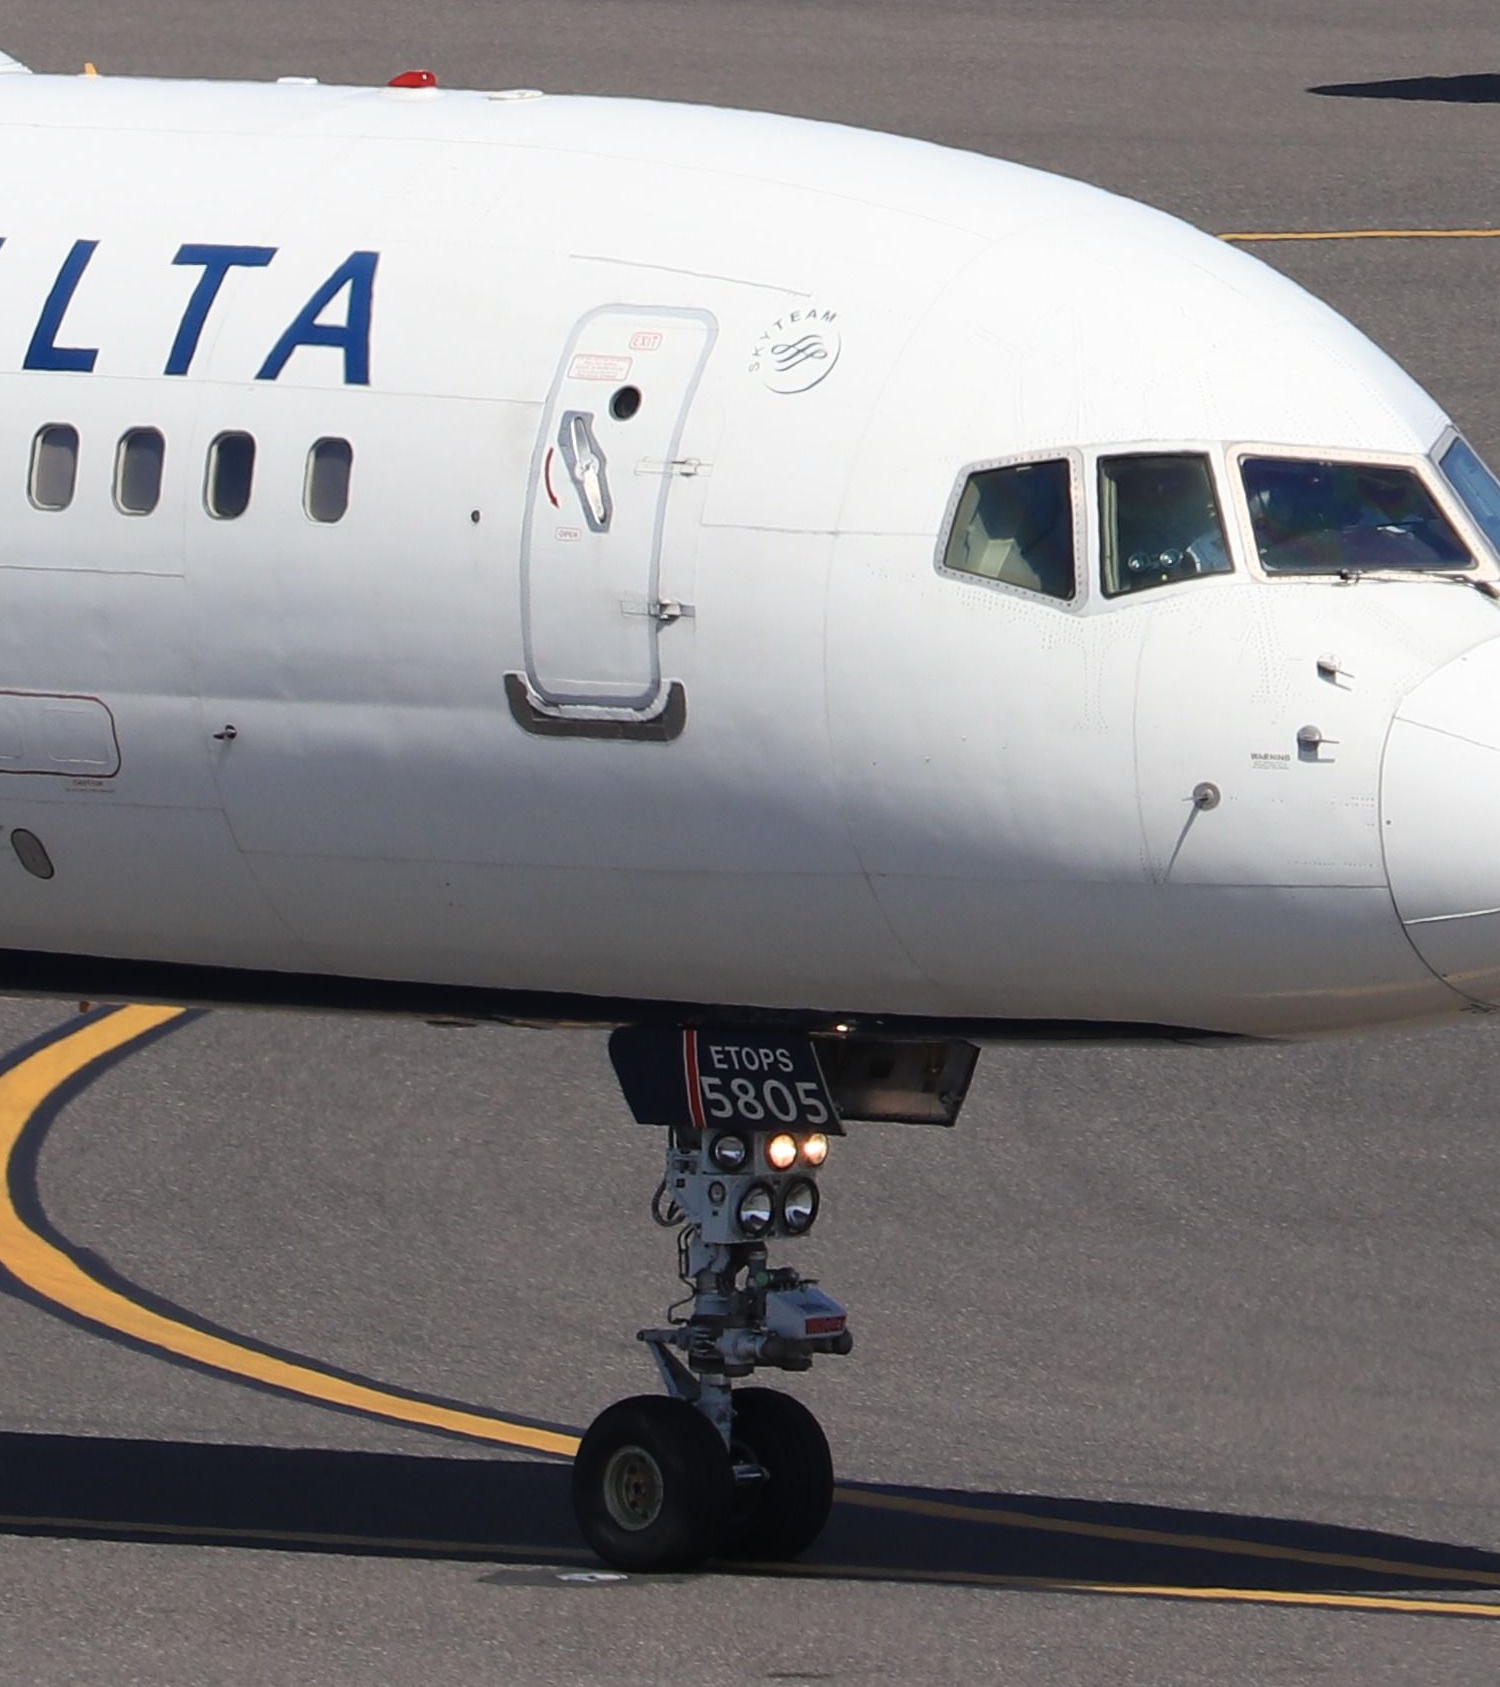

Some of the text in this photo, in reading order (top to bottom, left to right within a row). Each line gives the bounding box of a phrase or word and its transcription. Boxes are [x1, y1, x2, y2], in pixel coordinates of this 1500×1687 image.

[633, 335, 659, 348] EXIT
[747, 307, 838, 374] SKYTEAM
[709, 1044, 794, 1073] ETOPS
[701, 1076, 830, 1125] 5805
